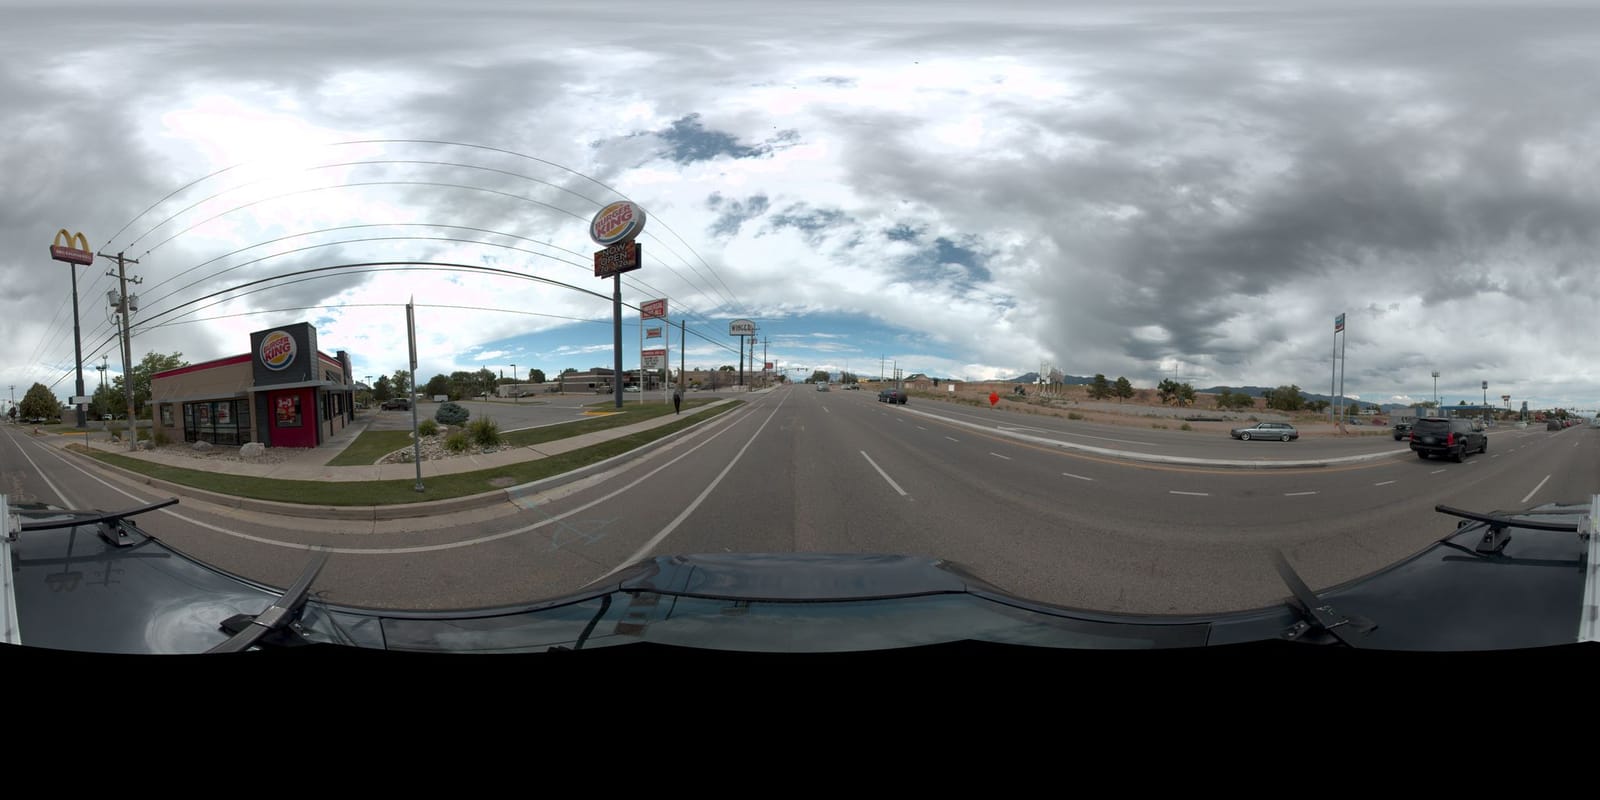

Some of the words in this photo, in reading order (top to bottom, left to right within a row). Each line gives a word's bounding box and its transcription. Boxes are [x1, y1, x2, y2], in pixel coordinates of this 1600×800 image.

[595, 203, 632, 229] BURGER
[597, 212, 633, 238] KING
[600, 252, 627, 265] OPEN
[603, 243, 626, 256] NOW
[264, 336, 289, 354] BURGER
[265, 343, 291, 361] KING
